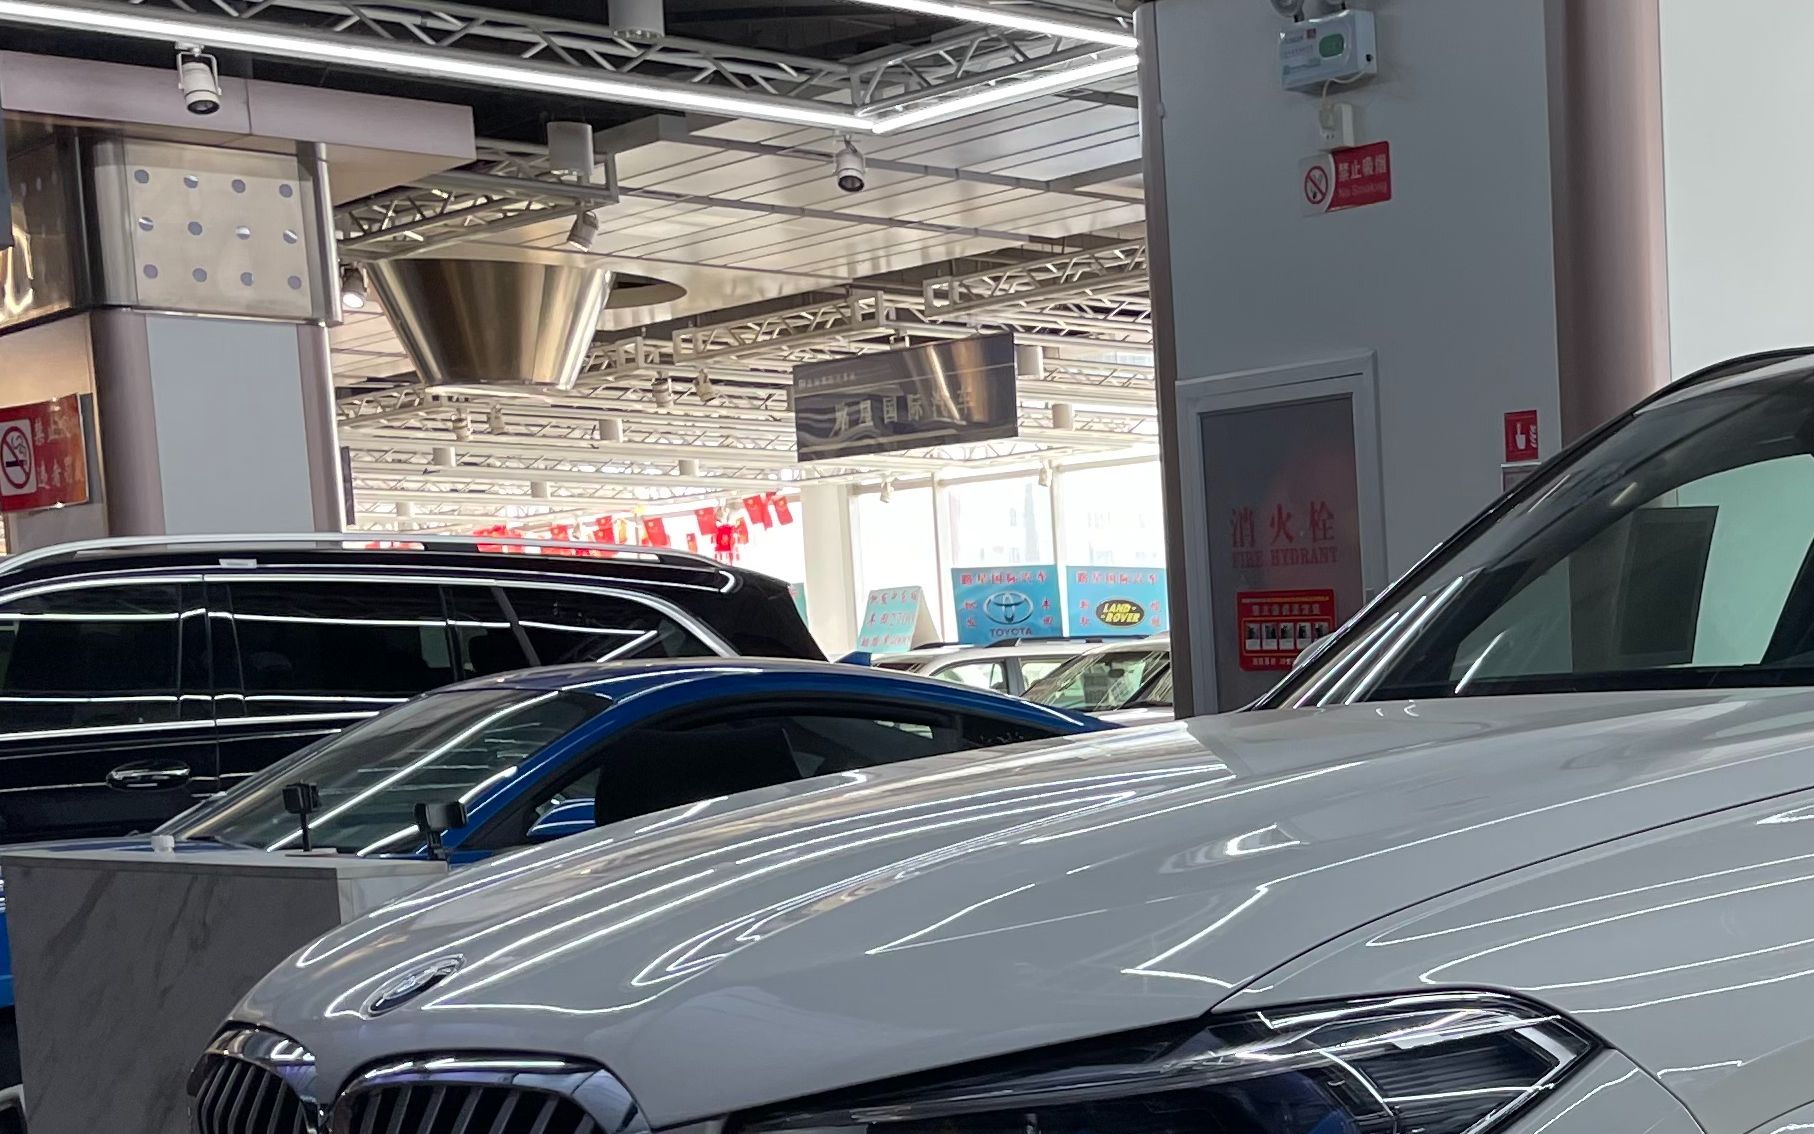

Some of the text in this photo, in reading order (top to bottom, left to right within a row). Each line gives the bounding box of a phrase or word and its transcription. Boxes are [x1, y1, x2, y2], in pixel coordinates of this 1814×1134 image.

[1231, 501, 1335, 548] 消火栓
[1270, 546, 1338, 566] HYDRANT
[1103, 603, 1131, 613] LAND
[1106, 613, 1140, 622] ROVER
[989, 627, 1033, 638] TOYOTA
